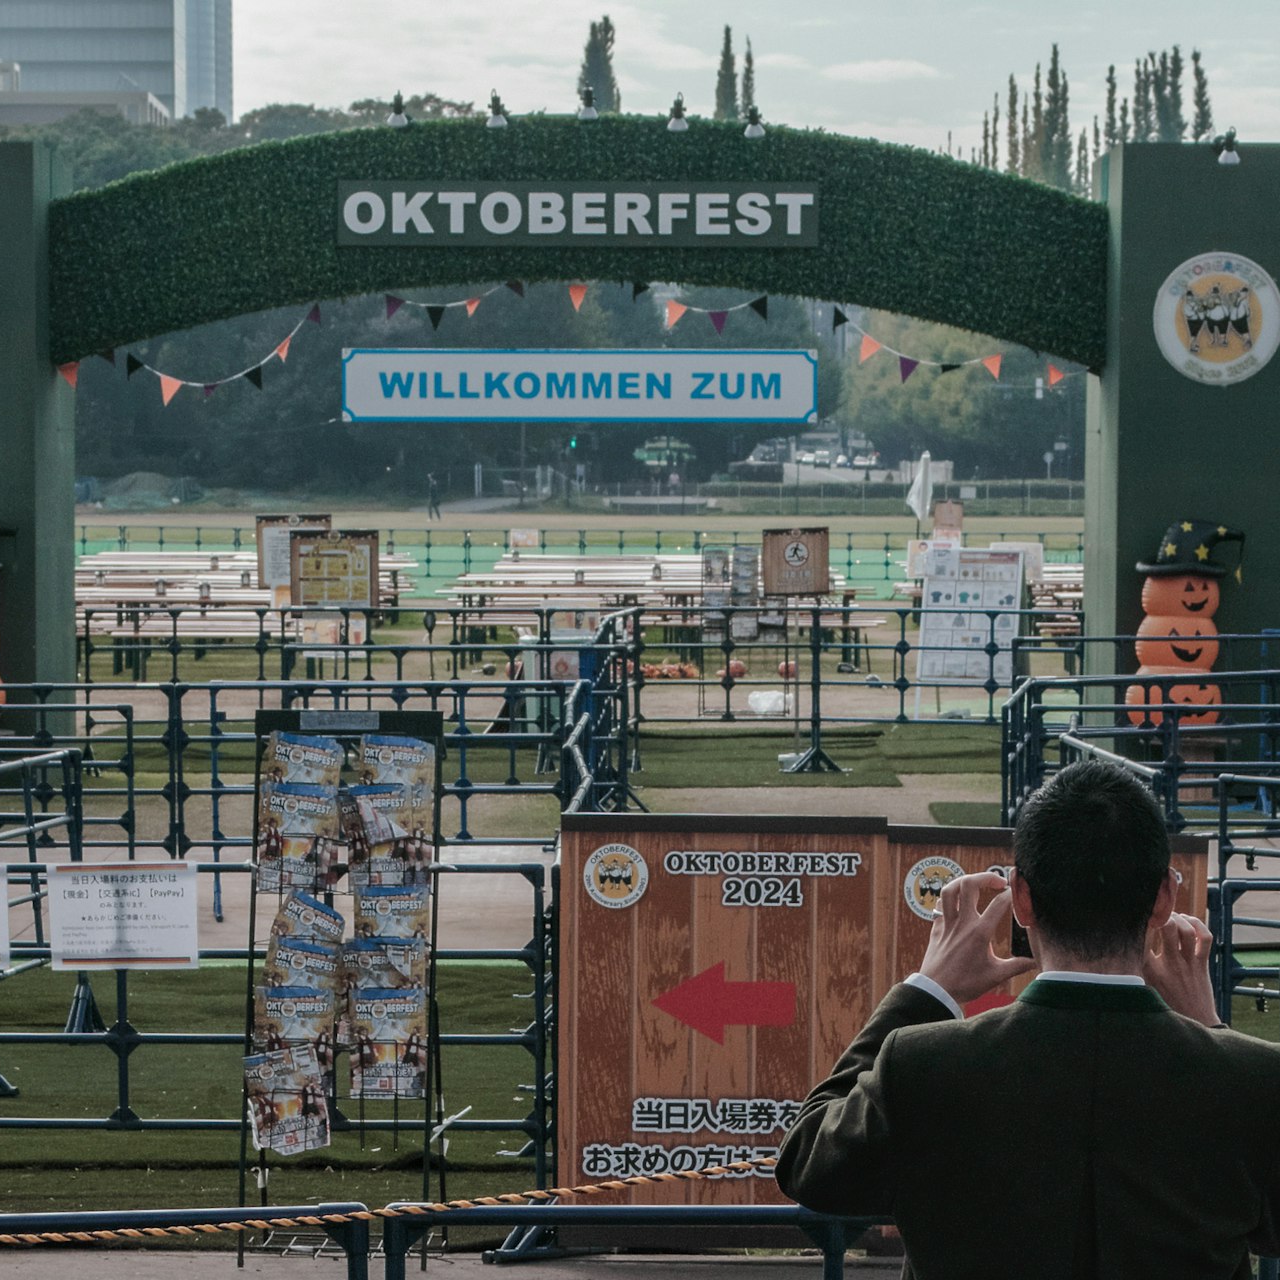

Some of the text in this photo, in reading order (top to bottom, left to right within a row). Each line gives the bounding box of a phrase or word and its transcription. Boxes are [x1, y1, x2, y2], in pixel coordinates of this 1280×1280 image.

[342, 191, 815, 235] OKTOBERFEST
[378, 371, 783, 400] WILLKOMMEN ZUM
[590, 845, 643, 864] OKTOBERFEST
[664, 851, 861, 876] OKTOBERFEST
[71, 874, 177, 885] 当日入場料のお支払いは
[722, 878, 803, 907] 2024
[633, 1098, 802, 1133] 当日入場券を
